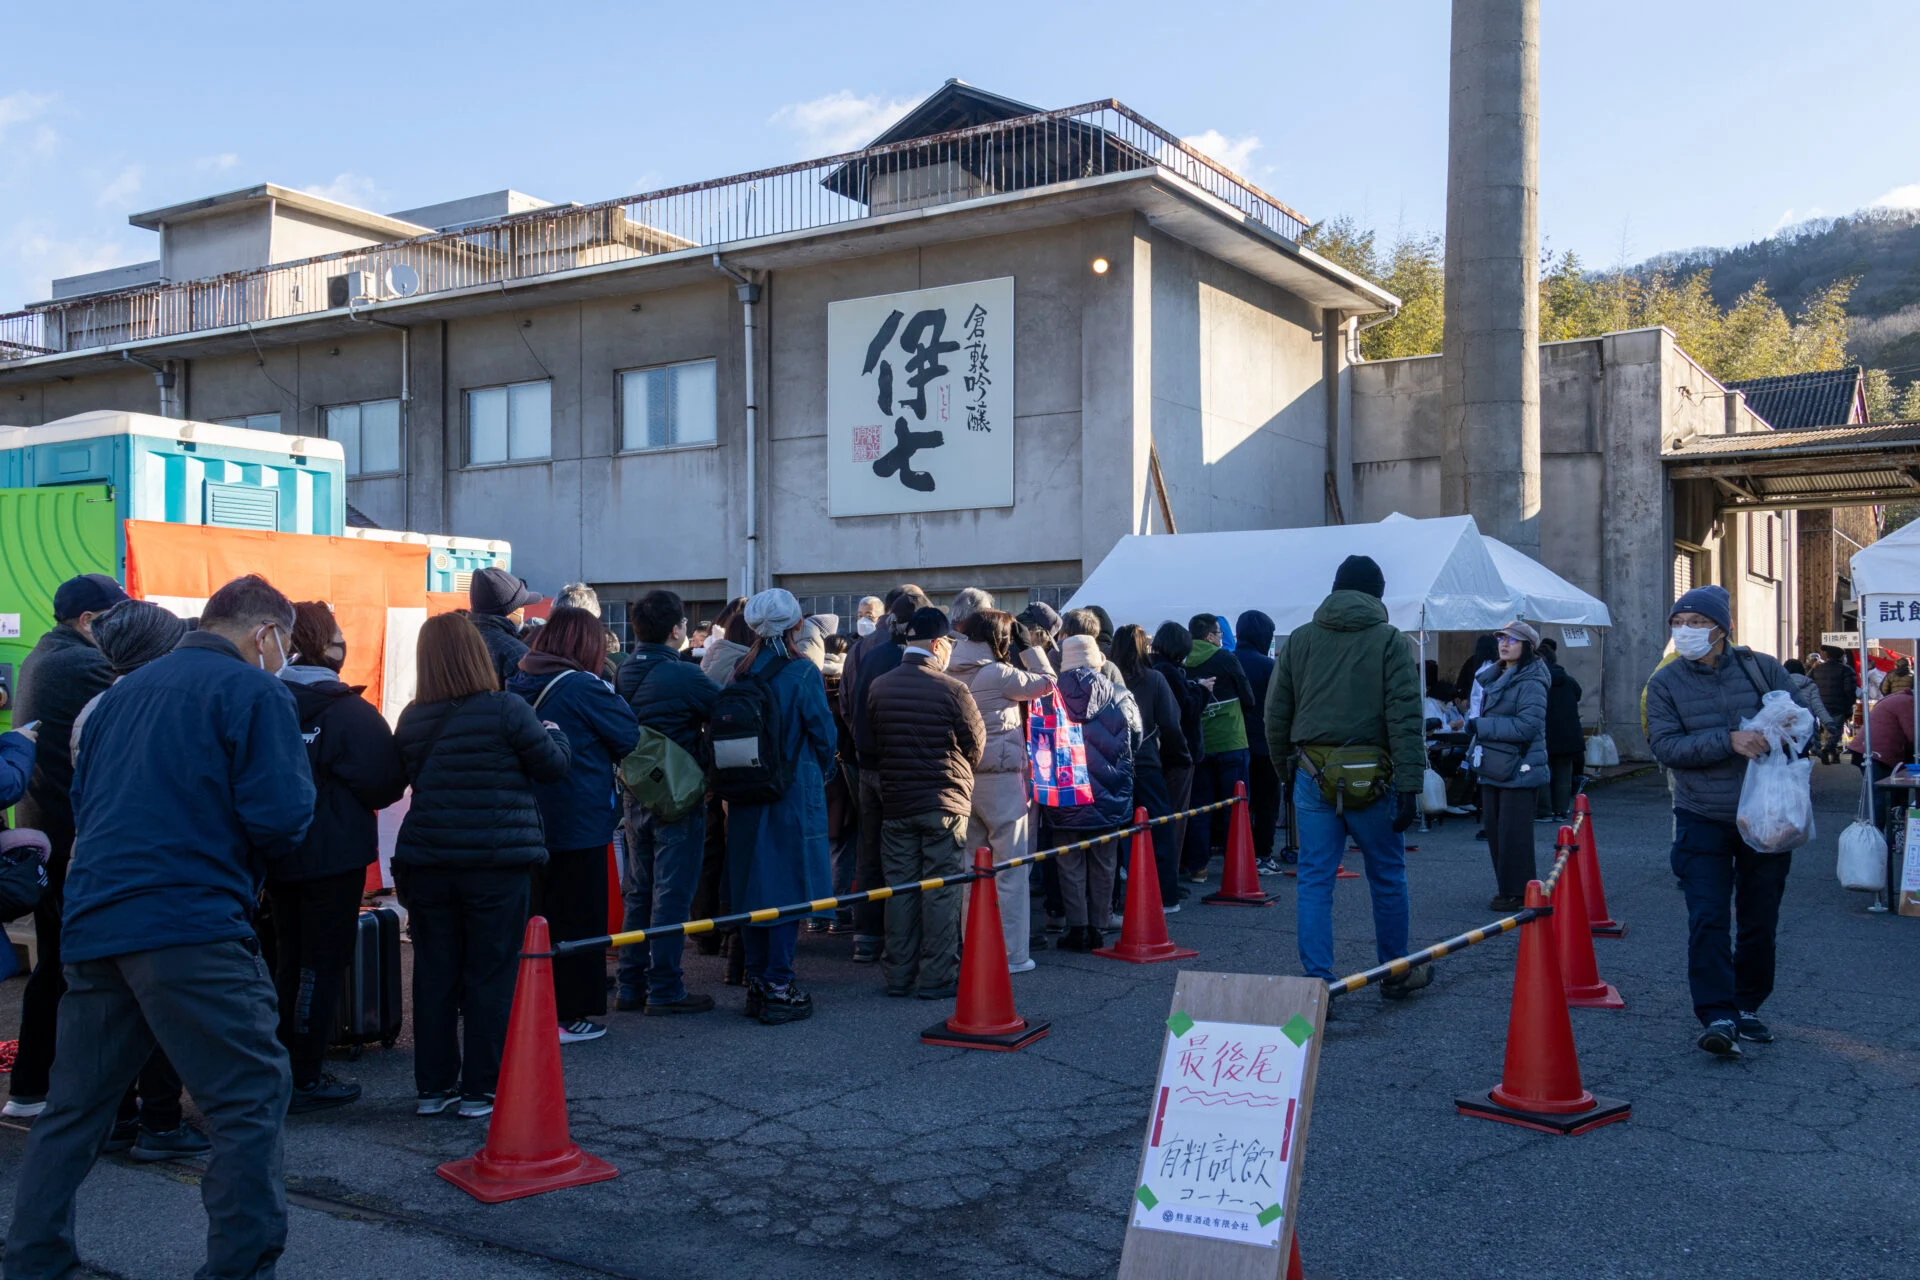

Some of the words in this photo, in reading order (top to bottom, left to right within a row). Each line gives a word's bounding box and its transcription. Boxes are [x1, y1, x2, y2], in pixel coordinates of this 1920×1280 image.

[861, 308, 961, 492] 伊七
[1175, 1034, 1283, 1088] 最後尾
[1159, 1132, 1275, 1189] 有料試飲
